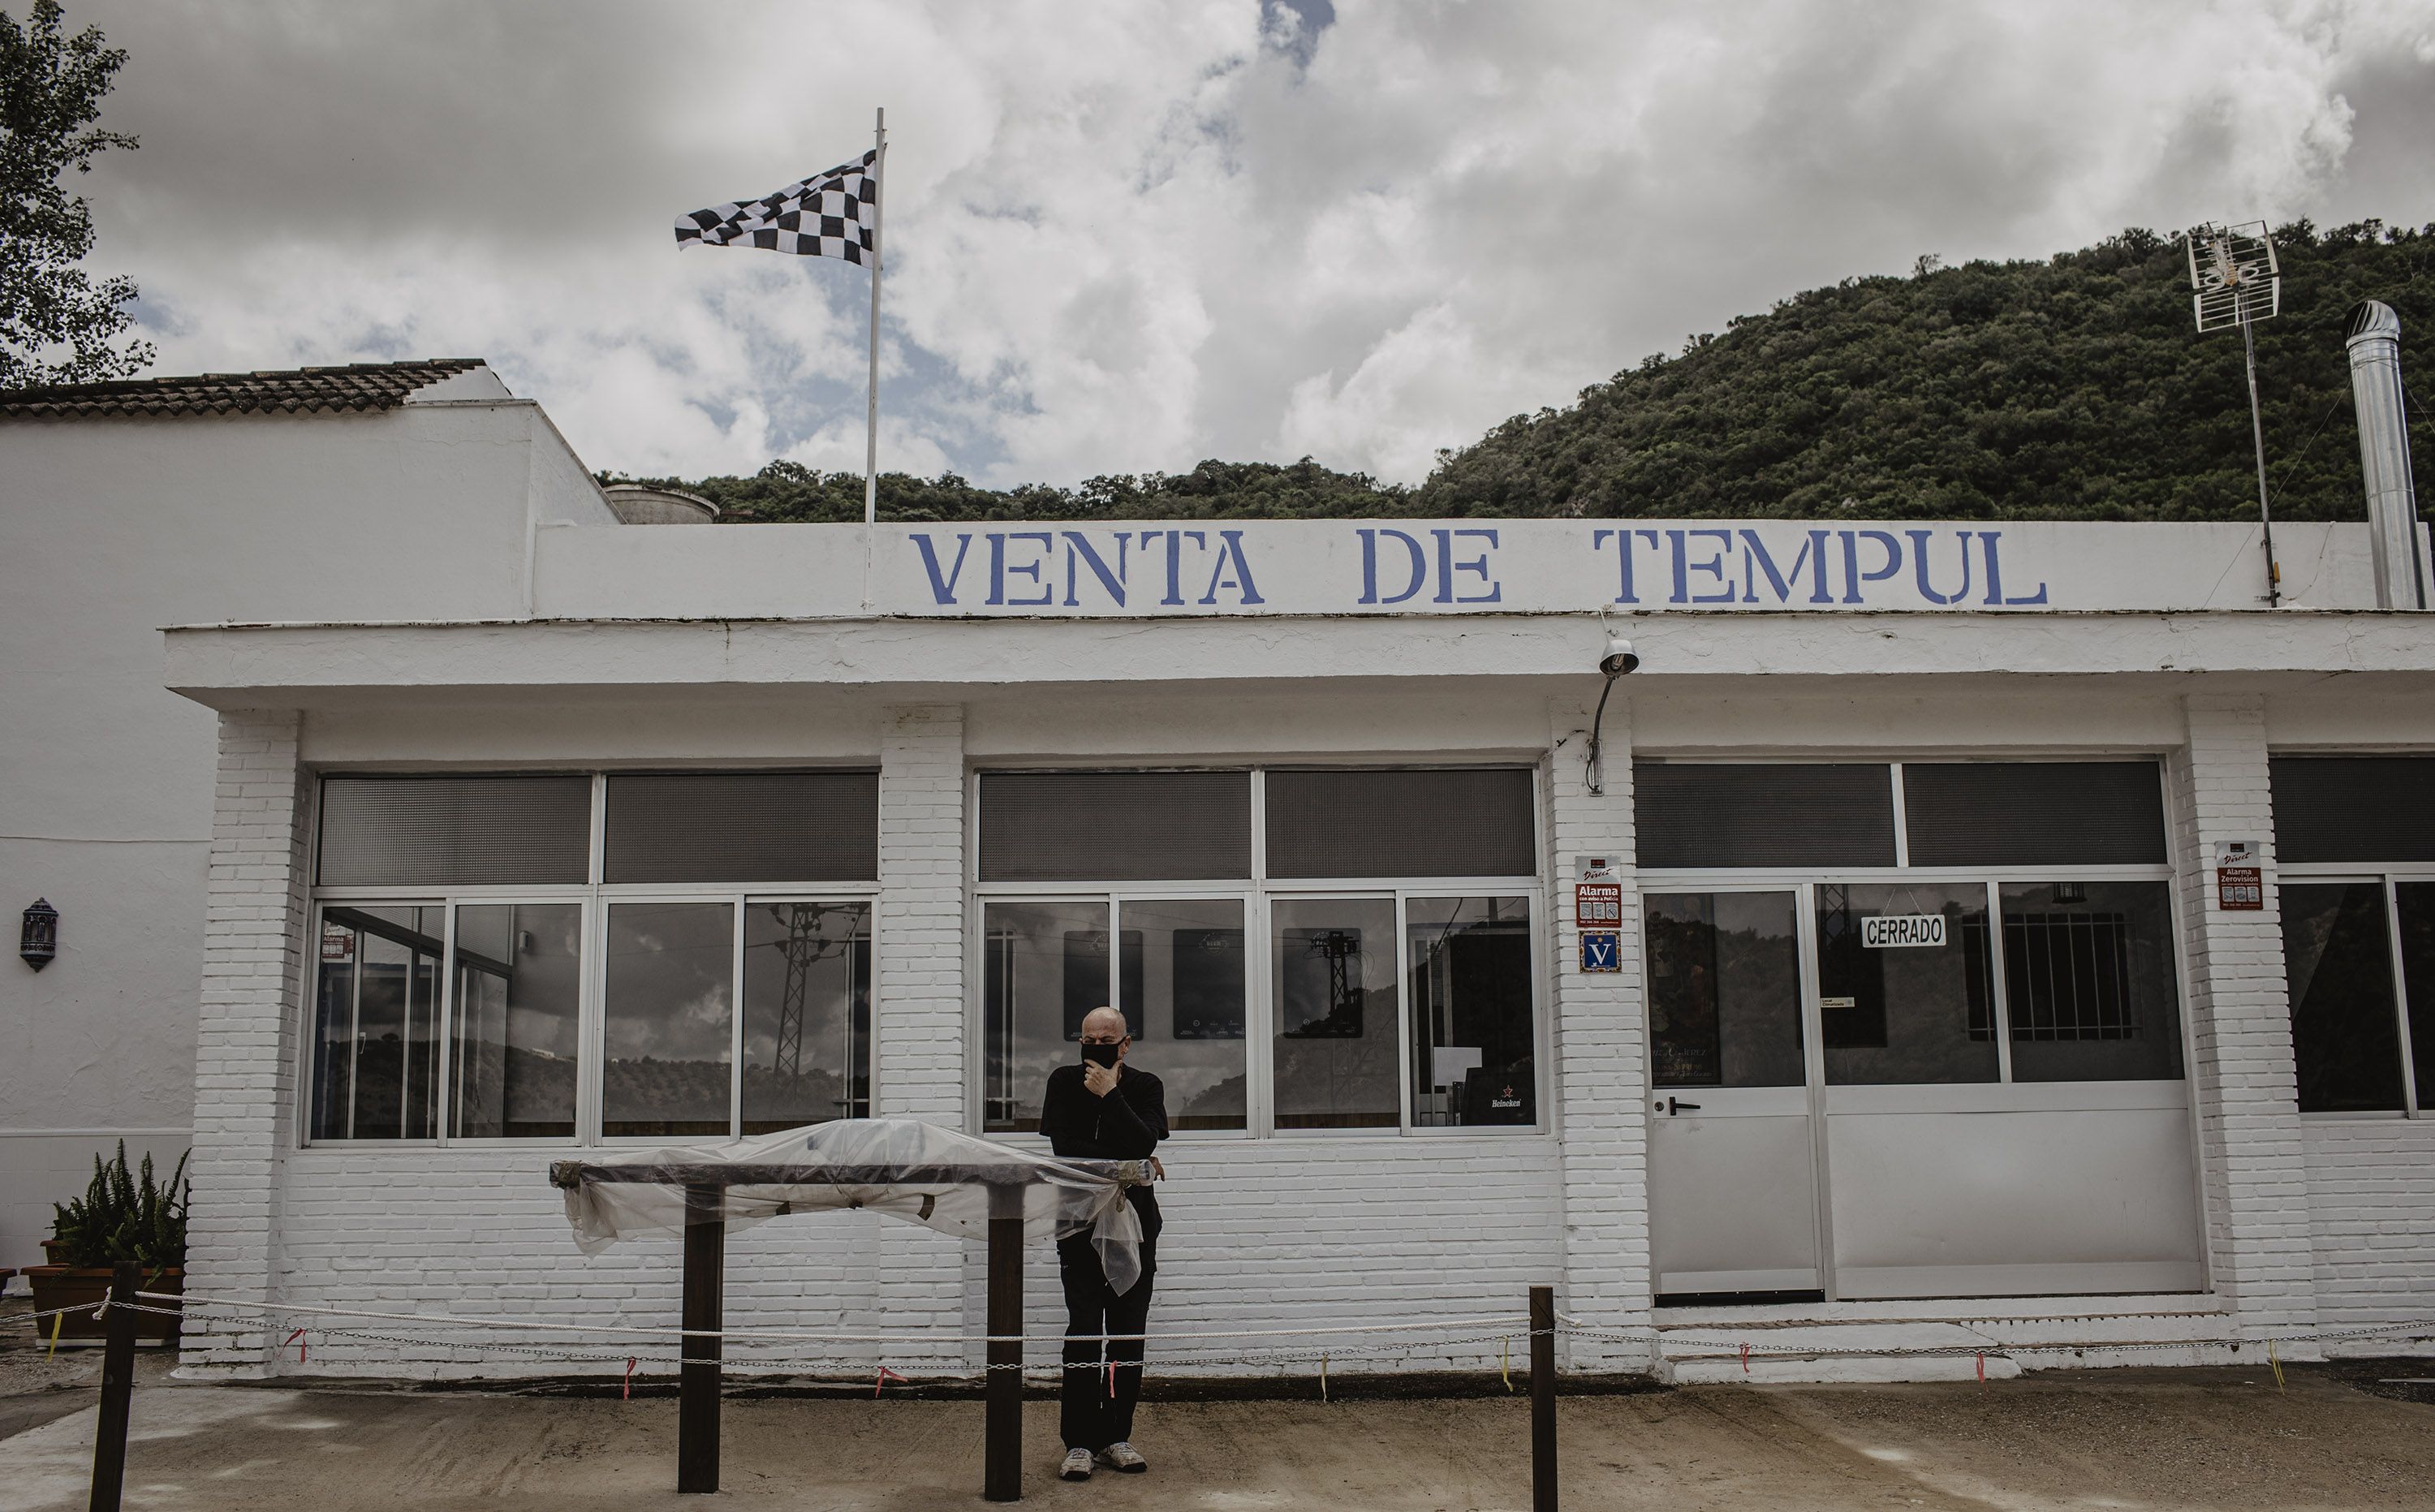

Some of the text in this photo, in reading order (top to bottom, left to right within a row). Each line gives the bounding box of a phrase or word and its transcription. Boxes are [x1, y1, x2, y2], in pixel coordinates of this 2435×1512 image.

[908, 528, 2049, 608] VENTA DE TEMPUL
[2224, 851, 2252, 864] Direct
[1583, 868, 1611, 881] Direct
[2221, 875, 2259, 883] Zerovision
[1579, 885, 1618, 895] Alarma
[1867, 918, 1942, 945] CERRADO
[1588, 944, 1611, 964] V
[1491, 1099, 1522, 1108] Heineken
